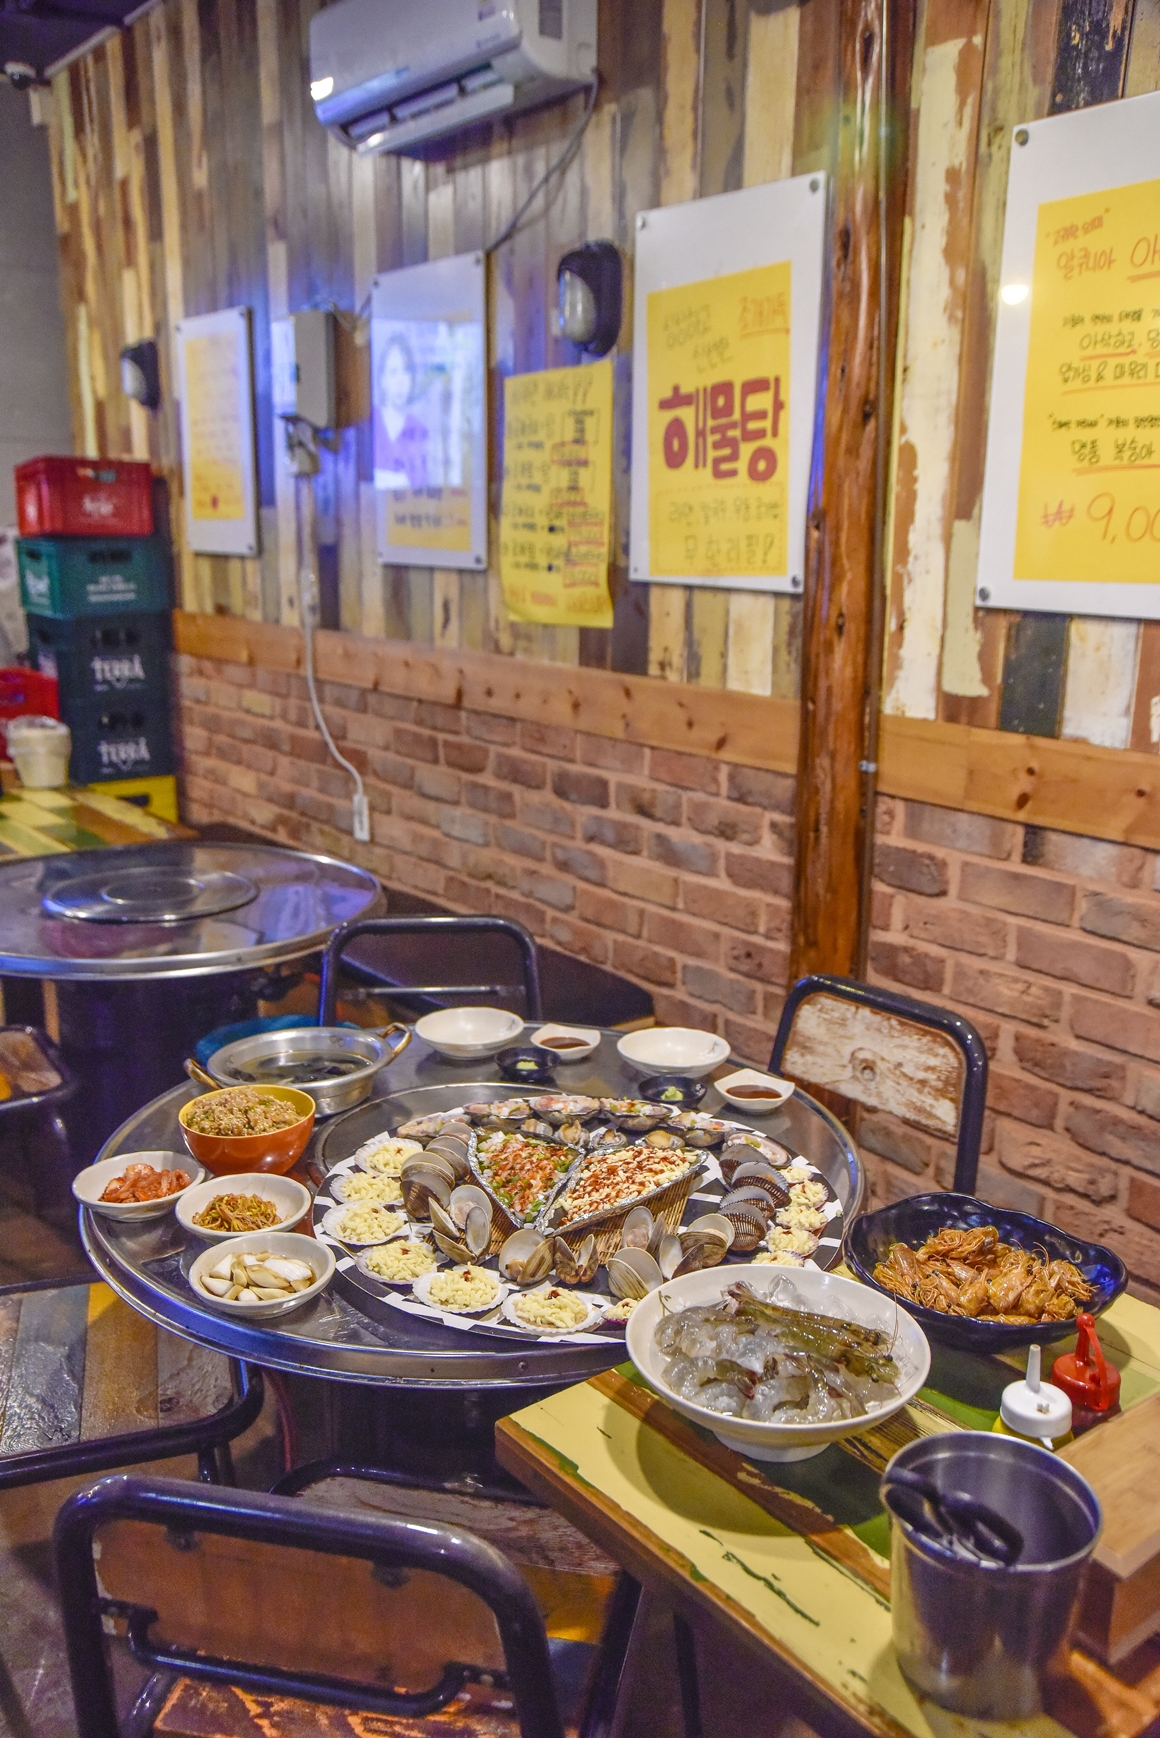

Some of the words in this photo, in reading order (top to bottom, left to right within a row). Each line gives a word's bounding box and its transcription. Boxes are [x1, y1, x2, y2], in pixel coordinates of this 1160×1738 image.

[1130, 233, 1160, 268] 아
[658, 375, 785, 484] 해물탕
[1069, 438, 1101, 466] 명품
[1112, 436, 1156, 464] 복숭아
[91, 654, 146, 682] TERRA
[98, 737, 151, 765] TERRA
